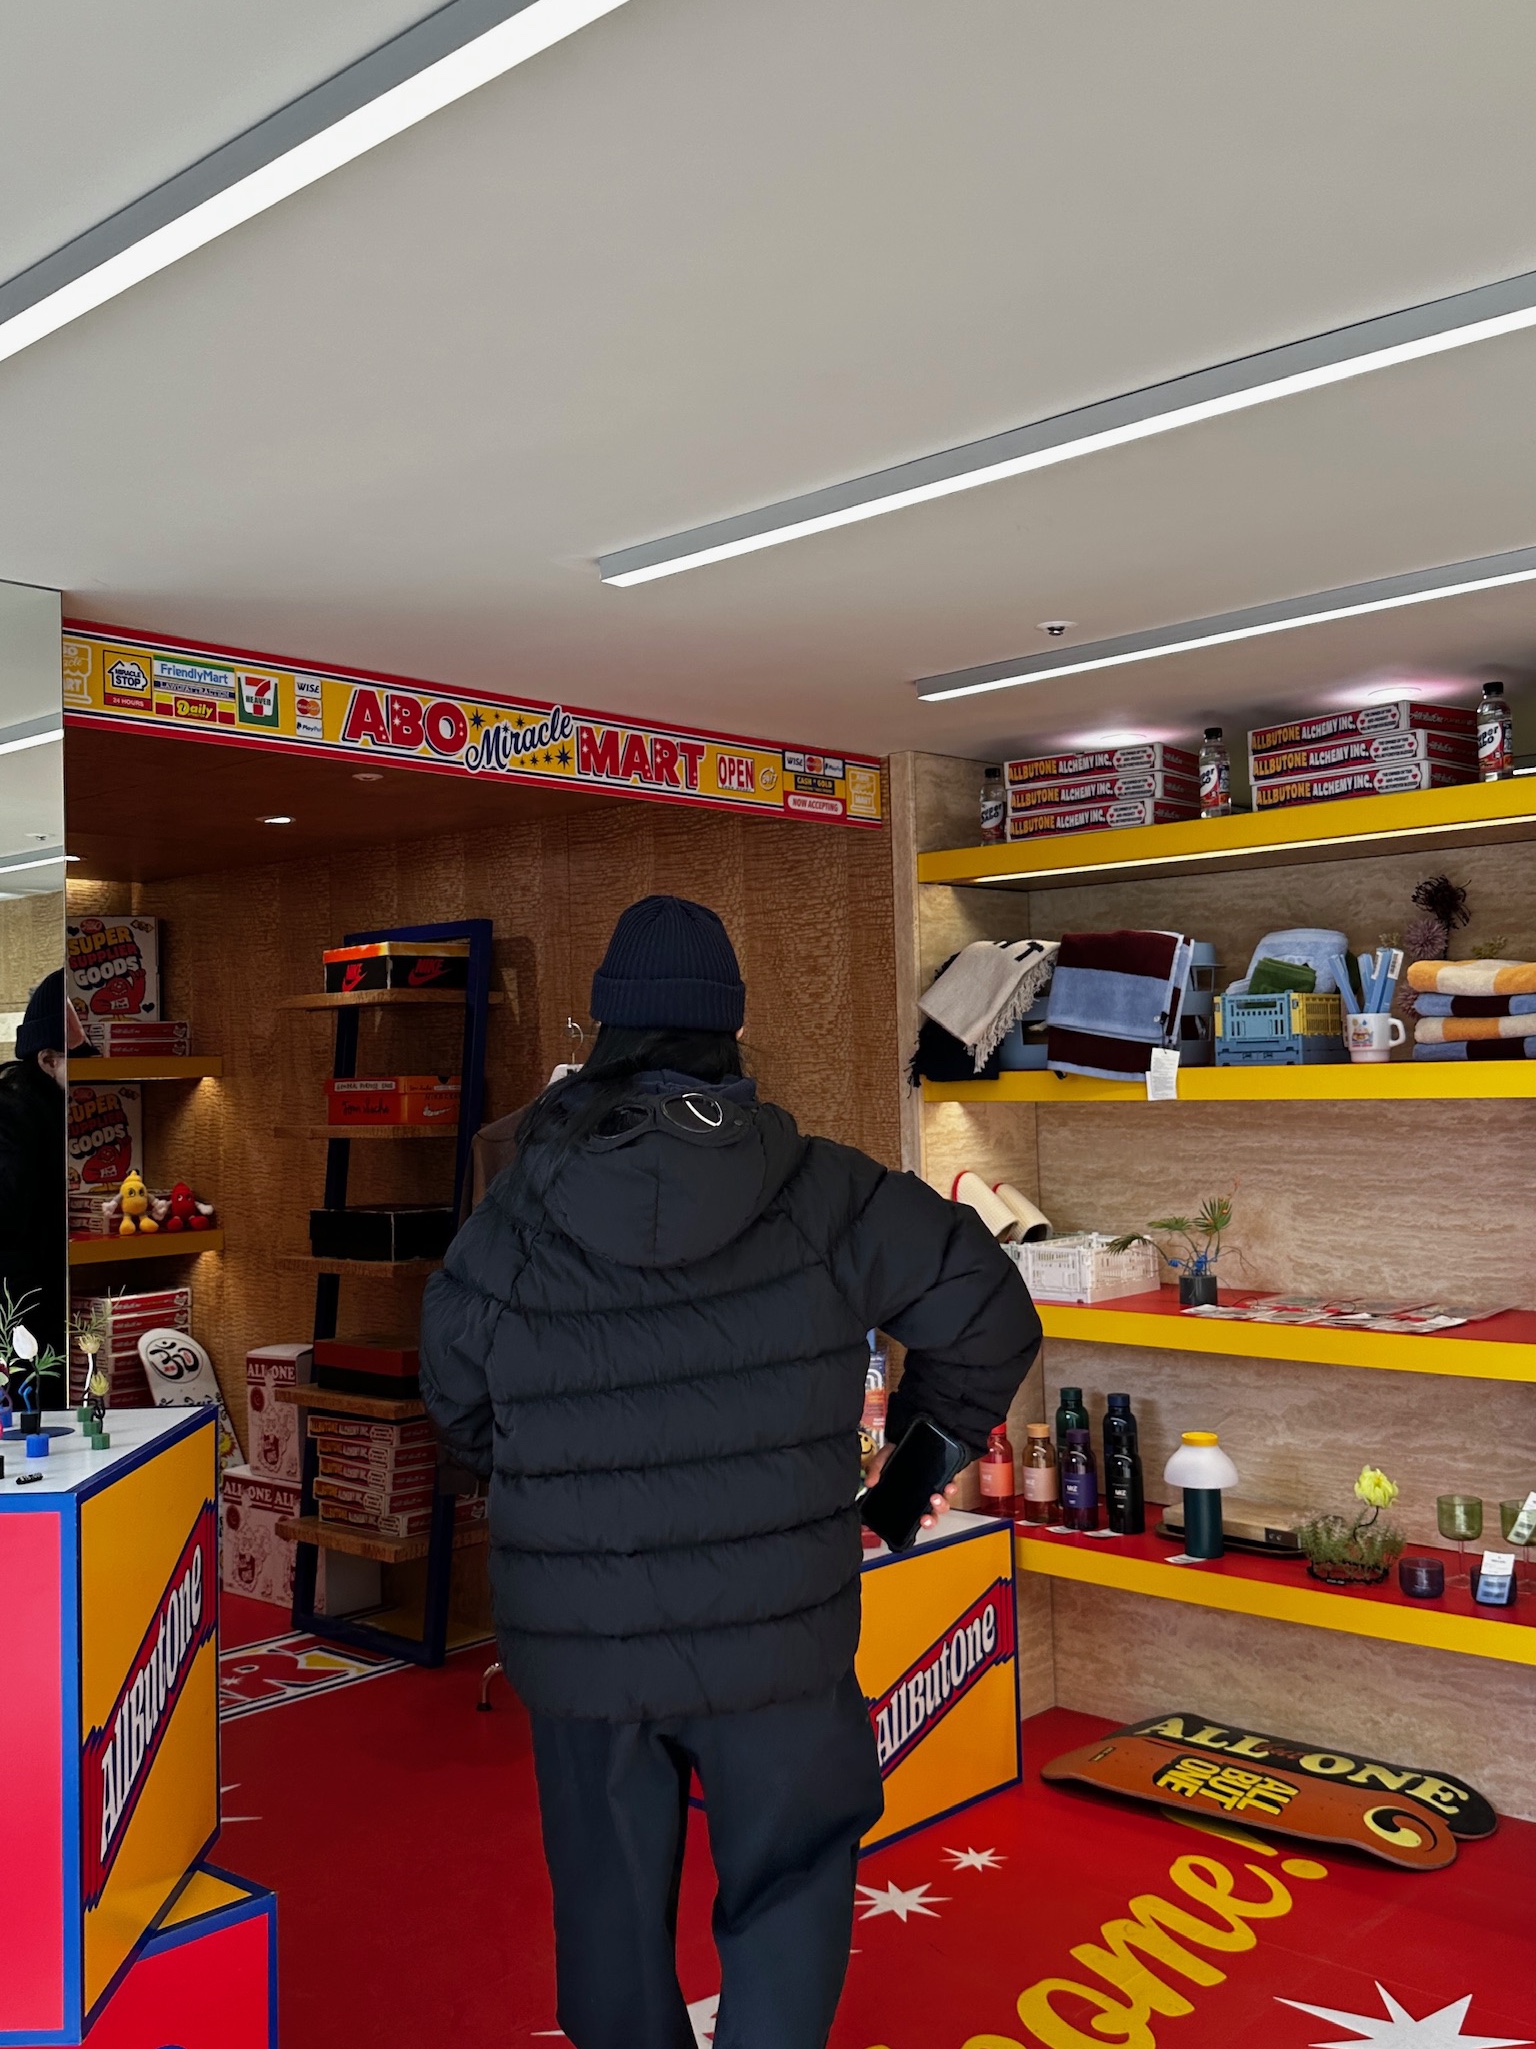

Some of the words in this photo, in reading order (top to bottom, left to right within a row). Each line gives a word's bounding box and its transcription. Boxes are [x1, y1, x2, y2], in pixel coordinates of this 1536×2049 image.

[115, 668, 141, 678] MIRACLE
[115, 675, 141, 687] STOP
[160, 663, 229, 685] FriendlyMart
[297, 682, 320, 693] WISE
[121, 698, 144, 707] HOURS
[176, 700, 213, 719] Daily
[342, 688, 469, 756] ABO
[466, 705, 574, 771] Miracle
[577, 725, 706, 788] MART
[1252, 726, 1301, 750] ALLBUTONE
[1301, 718, 1339, 740] ALCHEMY
[1339, 715, 1356, 731] INC.
[718, 756, 754, 789] OPEN
[1008, 760, 1057, 780] ALLBUTONE
[1059, 755, 1095, 774] ALCHEMY
[1095, 753, 1112, 767] INC.
[1253, 751, 1307, 776] ALLBUTONE
[1309, 745, 1351, 766] ALCHEMY
[1350, 743, 1369, 758] INC.
[792, 798, 807, 808] NOW
[808, 800, 839, 812] ACCEPTING
[1011, 787, 1060, 808] ALLBUTONE
[1060, 783, 1097, 801] ALCHEMY
[1096, 781, 1113, 796] INC.
[1257, 782, 1311, 806] ALLBUTONE
[1312, 776, 1354, 797] ALCHEMY
[1354, 774, 1373, 789] INC.
[1010, 818, 1055, 835] ALLBUTONE
[1056, 811, 1090, 828] ALCHEMY
[1089, 808, 1105, 823] INC.
[67, 925, 132, 956] SUPER
[69, 943, 139, 970] SUPPLIER
[74, 956, 140, 987] GOODS
[415, 957, 445, 973] NIKE
[69, 1123, 127, 1155] GOODS
[272, 1365, 296, 1381] ONE
[249, 1486, 273, 1503] ONE
[875, 1603, 996, 1767] AllButOne
[100, 1543, 202, 1864] AllButOne
[1134, 1717, 1271, 1759] ALL
[1299, 1753, 1470, 1815] ONE
[1156, 1757, 1221, 1798] ONE
[1199, 1766, 1266, 1812] BUT
[1235, 1775, 1300, 1816] ALL
[960, 1812, 1328, 2049] ome!
